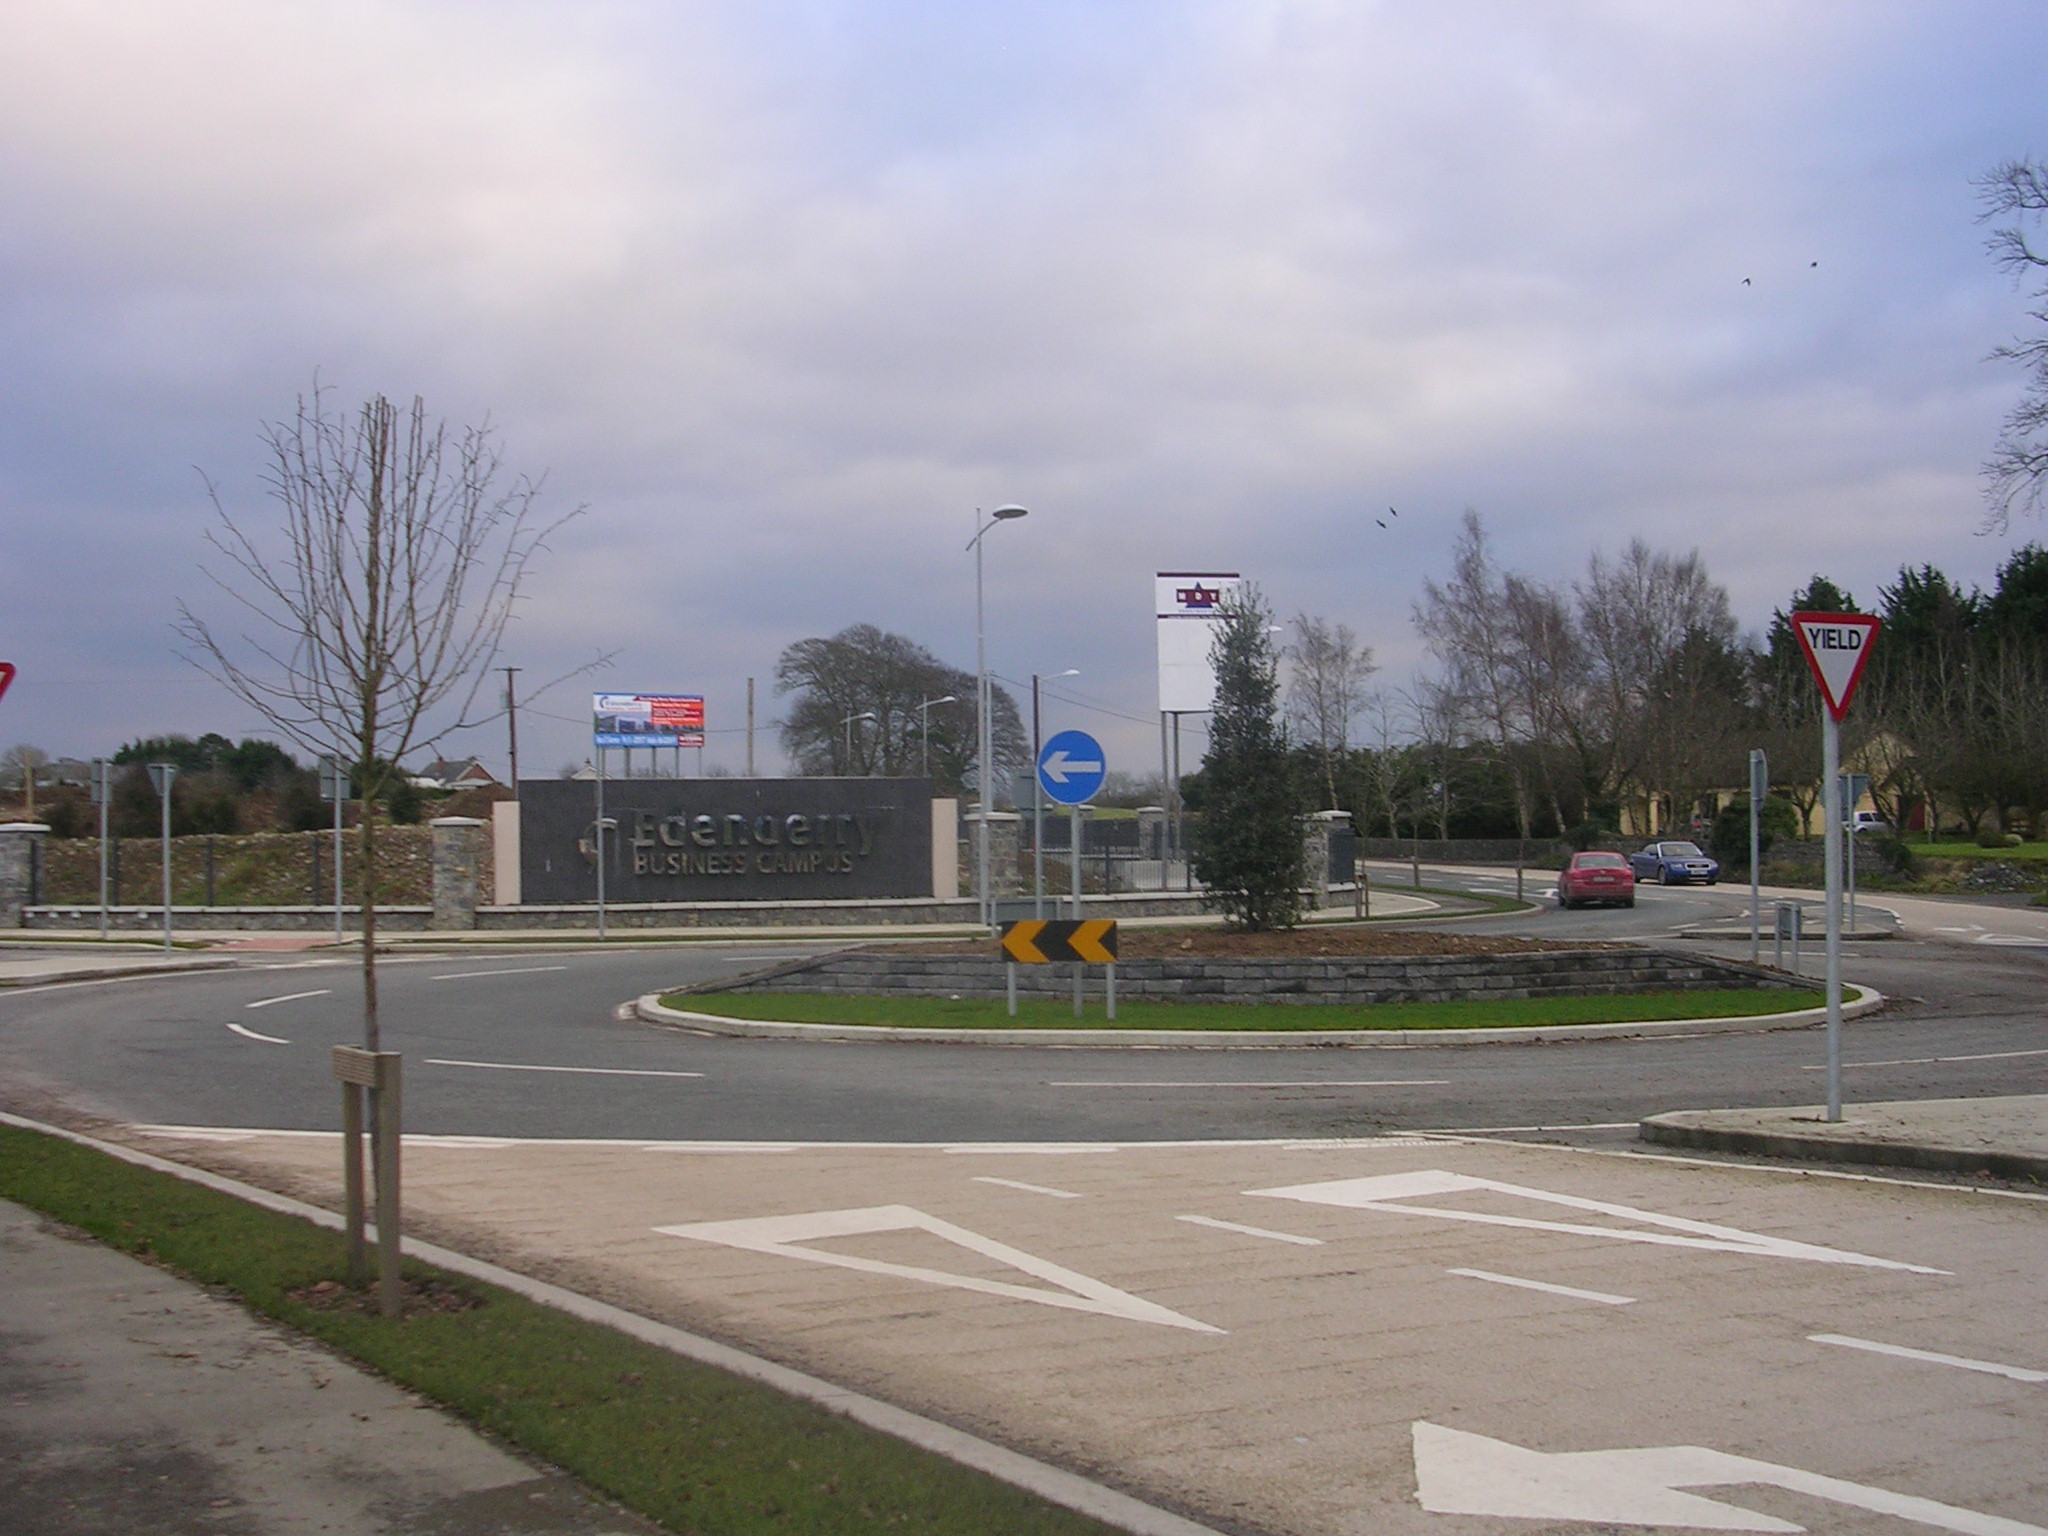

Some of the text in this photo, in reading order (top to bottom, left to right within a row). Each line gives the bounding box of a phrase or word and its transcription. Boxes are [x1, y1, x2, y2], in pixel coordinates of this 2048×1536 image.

[1808, 627, 1862, 650] YIELD
[631, 812, 875, 855] Edenderry
[633, 851, 854, 875] BUSINESS CAMPUS
